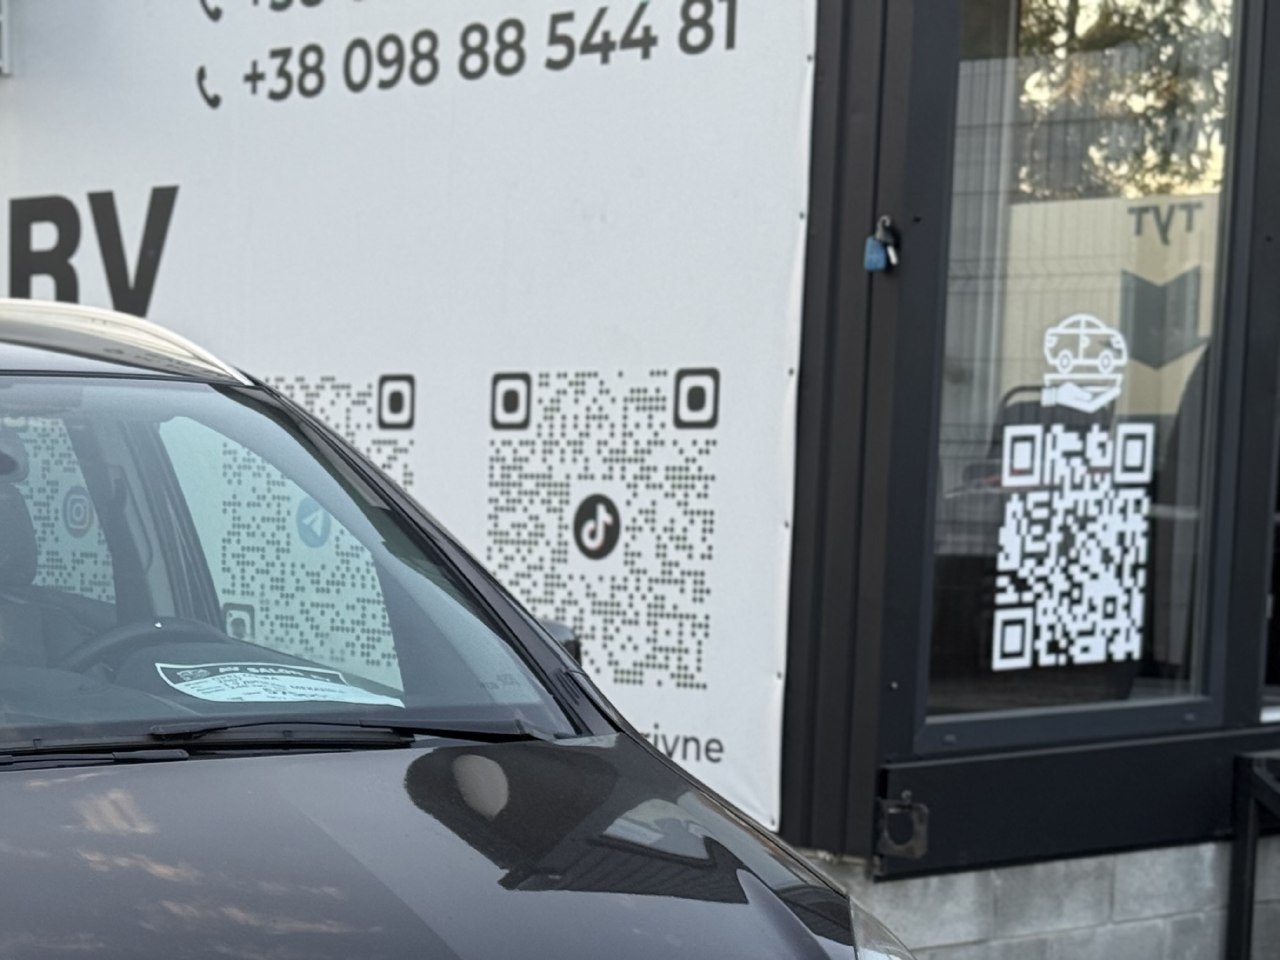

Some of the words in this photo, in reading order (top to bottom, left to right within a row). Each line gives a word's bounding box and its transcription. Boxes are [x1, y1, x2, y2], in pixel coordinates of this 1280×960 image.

[243, 43, 325, 101] +38
[343, 29, 440, 93] 098
[459, 18, 526, 80] 88
[545, 0, 658, 71] 544
[677, 0, 738, 55] 81
[9, 185, 180, 319] RV
